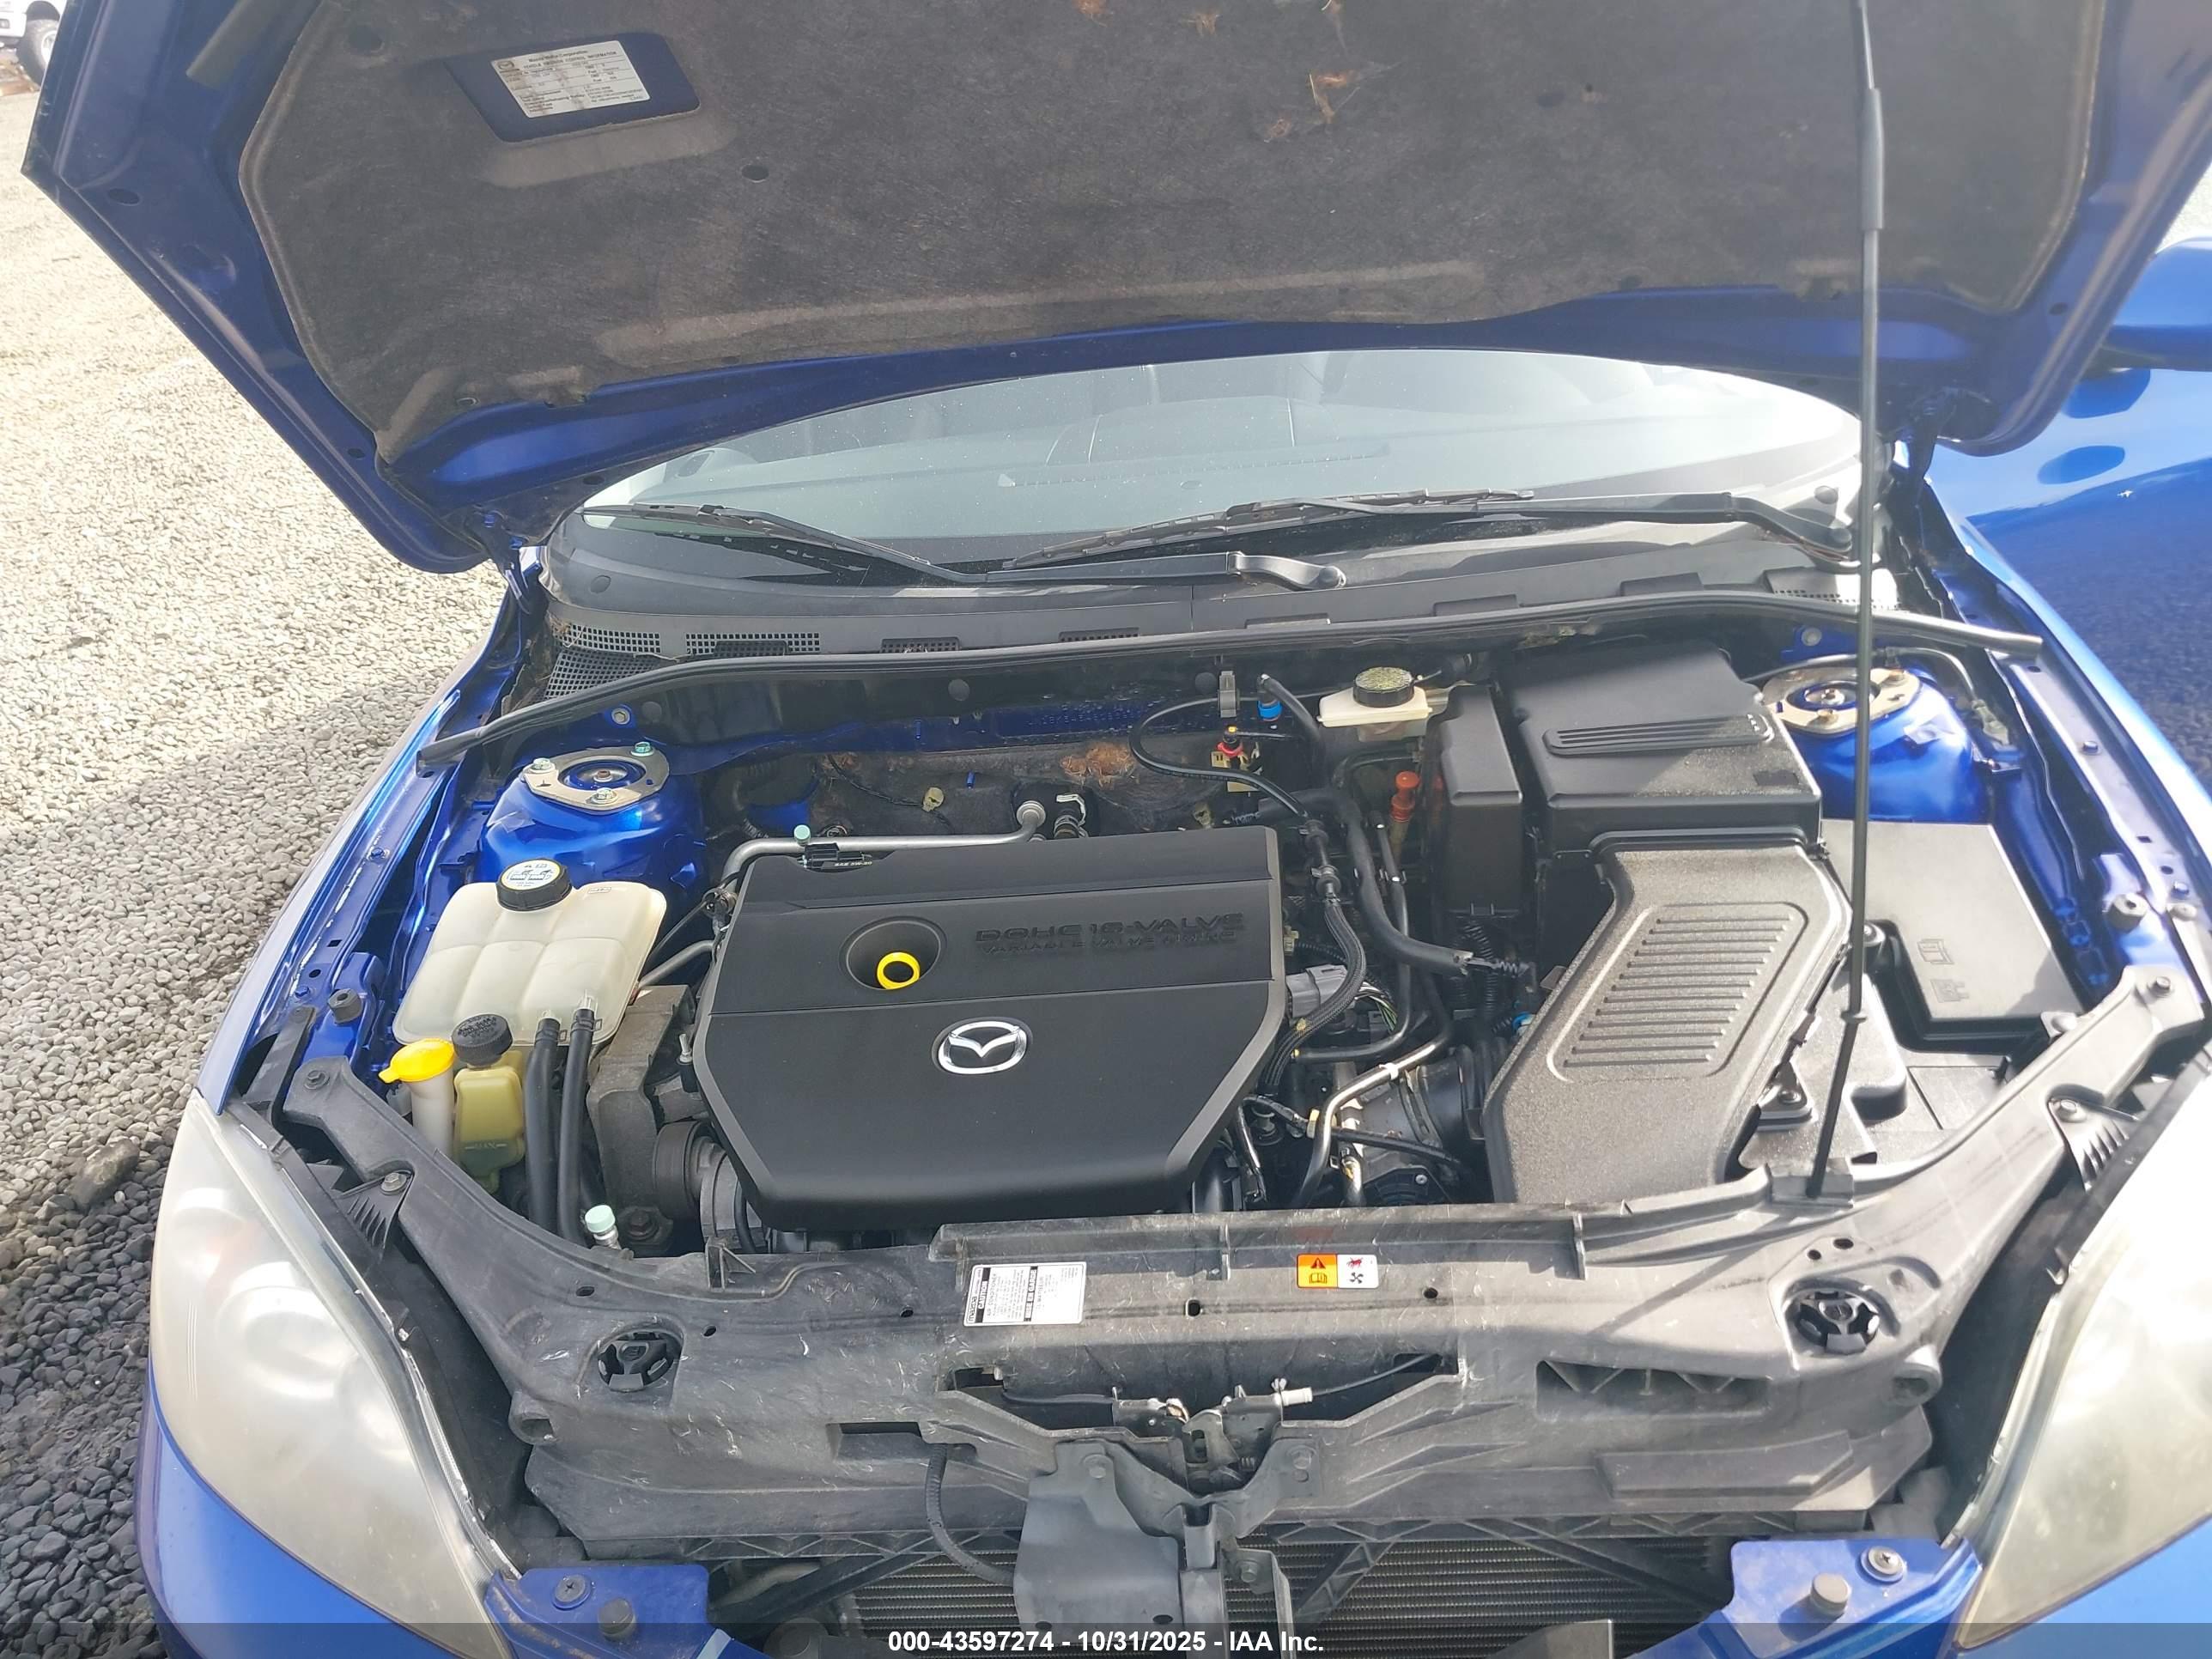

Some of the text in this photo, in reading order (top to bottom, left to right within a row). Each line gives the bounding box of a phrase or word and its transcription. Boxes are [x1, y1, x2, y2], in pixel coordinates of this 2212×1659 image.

[975, 923, 1082, 942] DOHC
[978, 1280, 988, 1310] CAUTION
[968, 1296, 977, 1322] mazda
